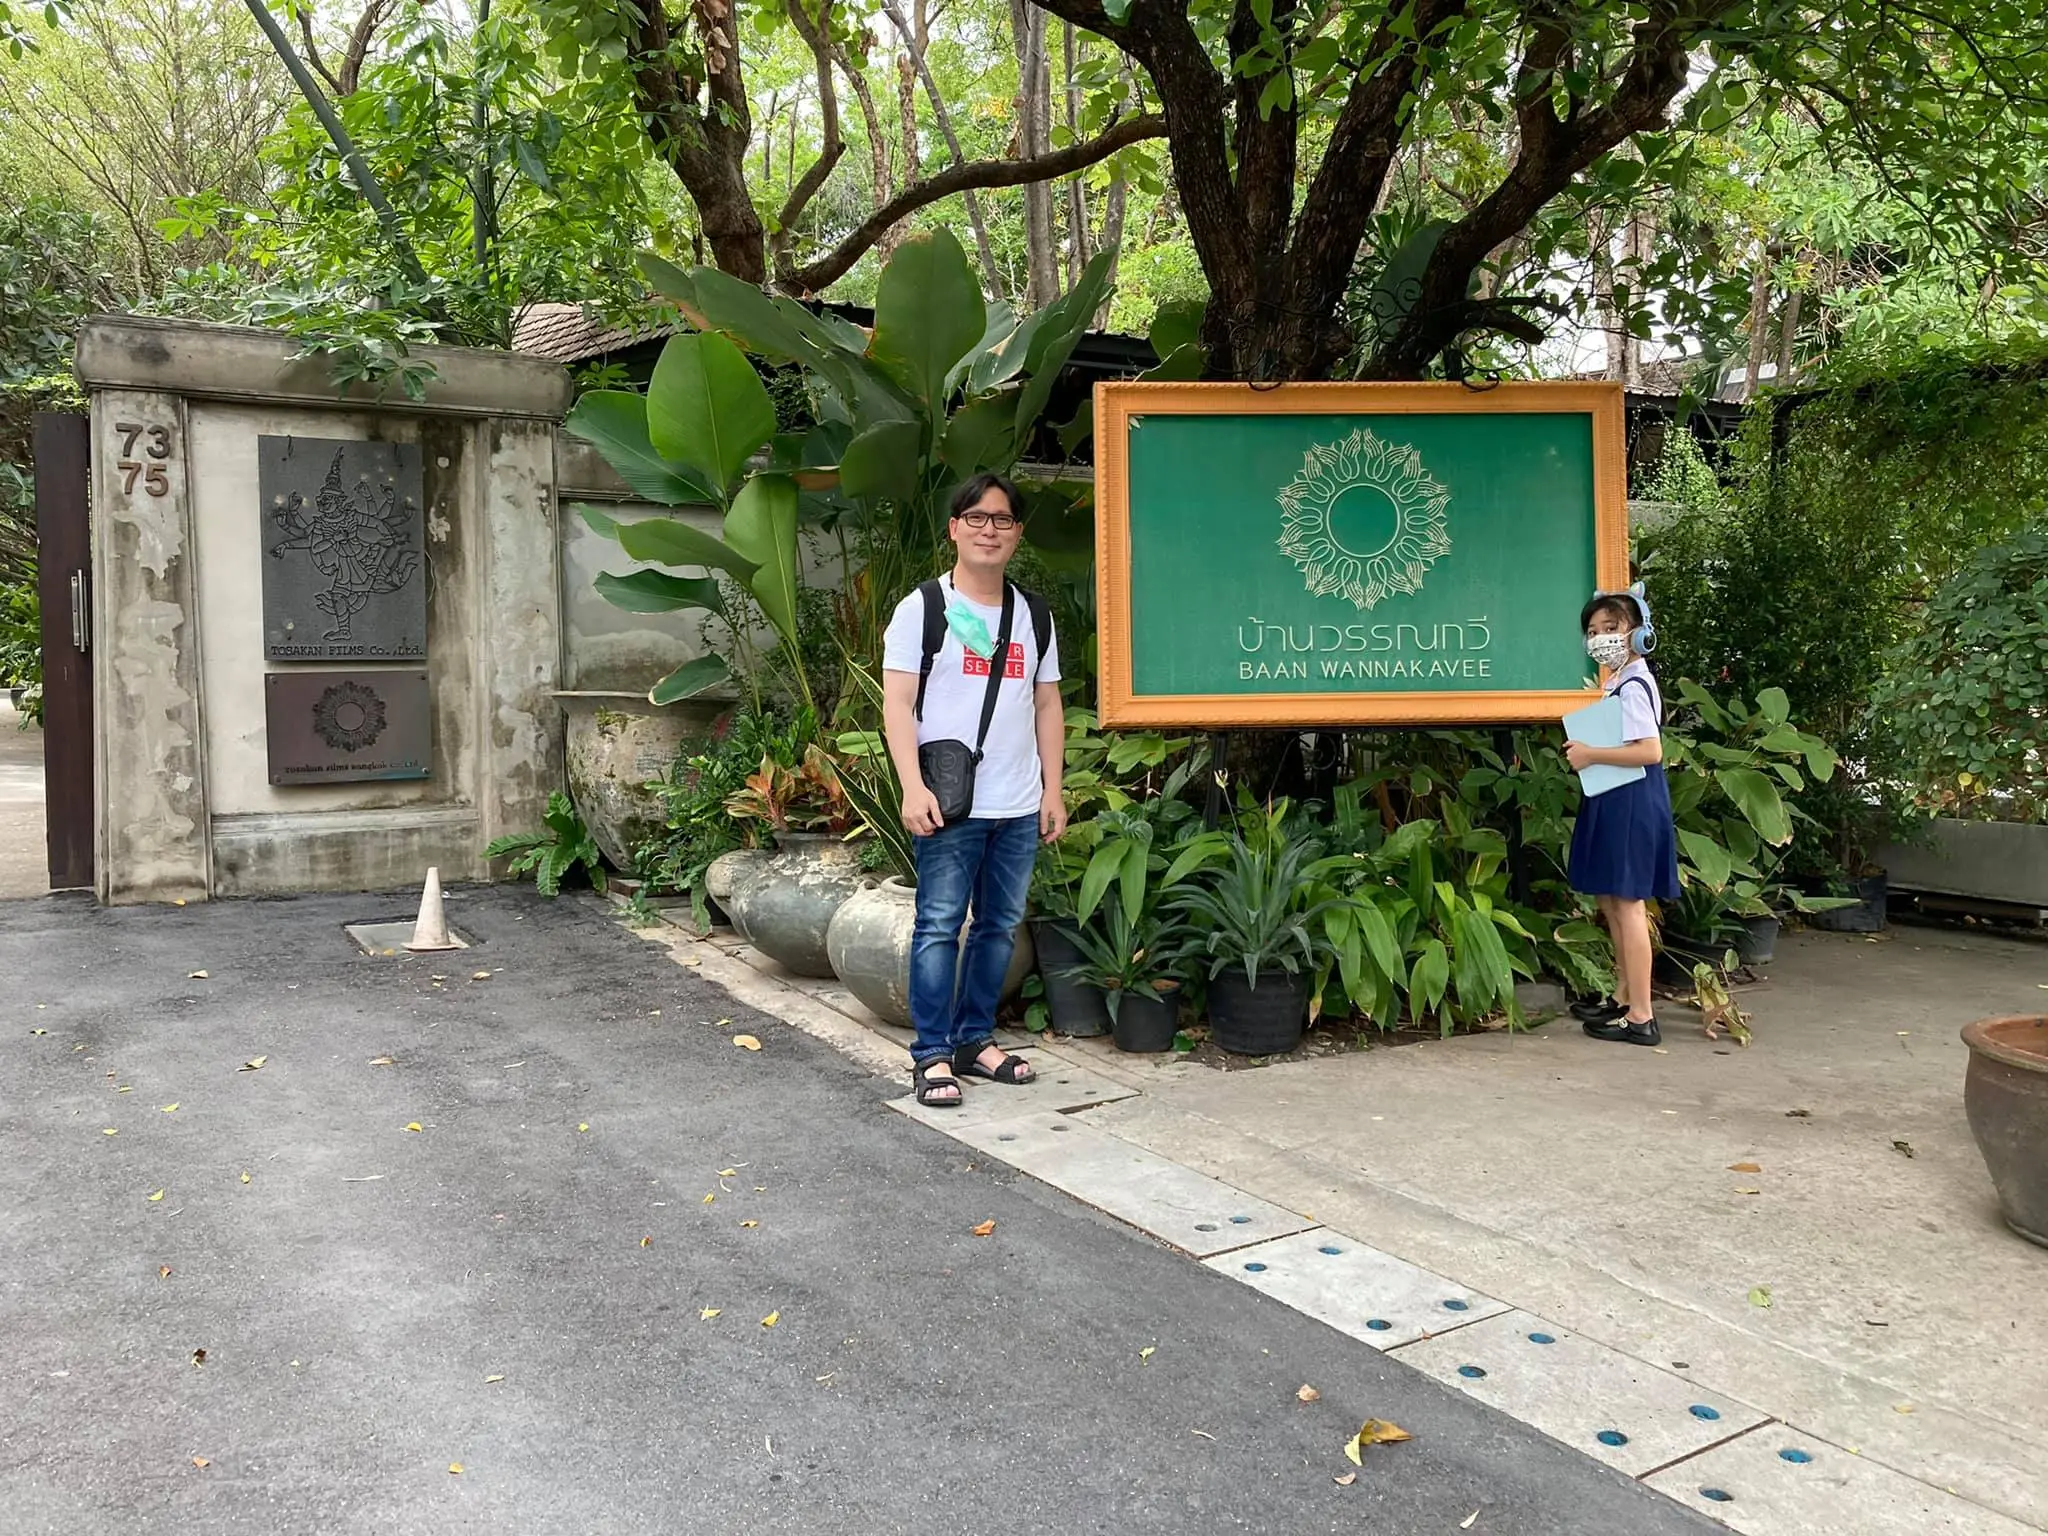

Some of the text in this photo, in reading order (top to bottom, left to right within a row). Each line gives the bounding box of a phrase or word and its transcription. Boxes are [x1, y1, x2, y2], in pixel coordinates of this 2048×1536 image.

[115, 422, 171, 460] 73
[117, 461, 170, 498] 75
[1238, 615, 1491, 652] บ้านวรรณกวี
[270, 645, 323, 657] TOSAKAN
[328, 645, 364, 656] FILMS
[964, 659, 1023, 677] SETLE
[1239, 658, 1492, 680] BAAN WANNAKAVEE
